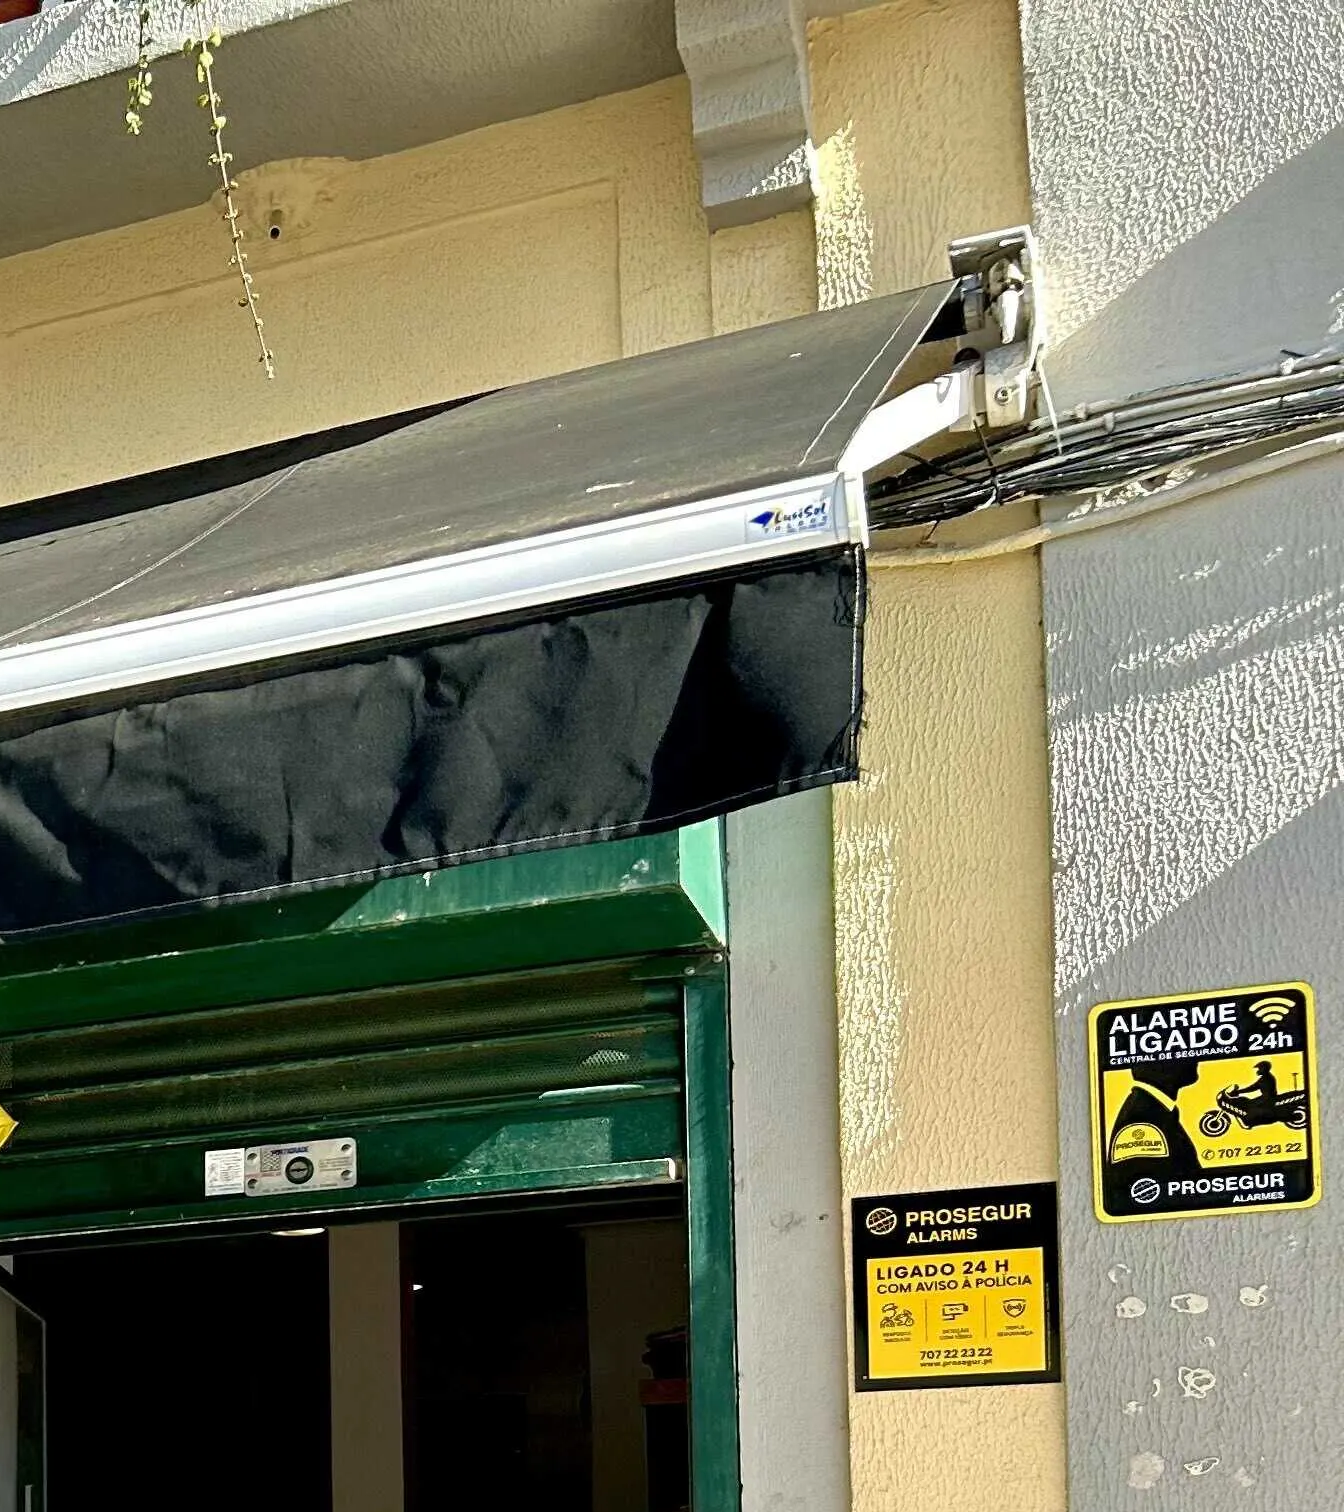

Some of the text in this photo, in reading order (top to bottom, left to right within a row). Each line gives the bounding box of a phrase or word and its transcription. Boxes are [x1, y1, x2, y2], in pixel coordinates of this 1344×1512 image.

[1109, 1002, 1237, 1035] ALARME
[1109, 1023, 1293, 1057] LIGADO 24h
[1110, 1045, 1239, 1065] CENTRAL DE SEGURANÇA
[1218, 1142, 1303, 1159] 707 22 23 22
[1167, 1172, 1285, 1196] PROSEGUR
[1232, 1191, 1286, 1204] ALARMES
[905, 1203, 1032, 1227] PROSEGUR
[906, 1227, 978, 1244] ALARMS
[876, 1259, 1010, 1281] LIGADO 24 H
[876, 1282, 912, 1294] COM
[915, 1279, 958, 1293] AVISO
[975, 1273, 1032, 1289] POLÍCIA
[920, 1347, 993, 1360] 707 22 23 22
